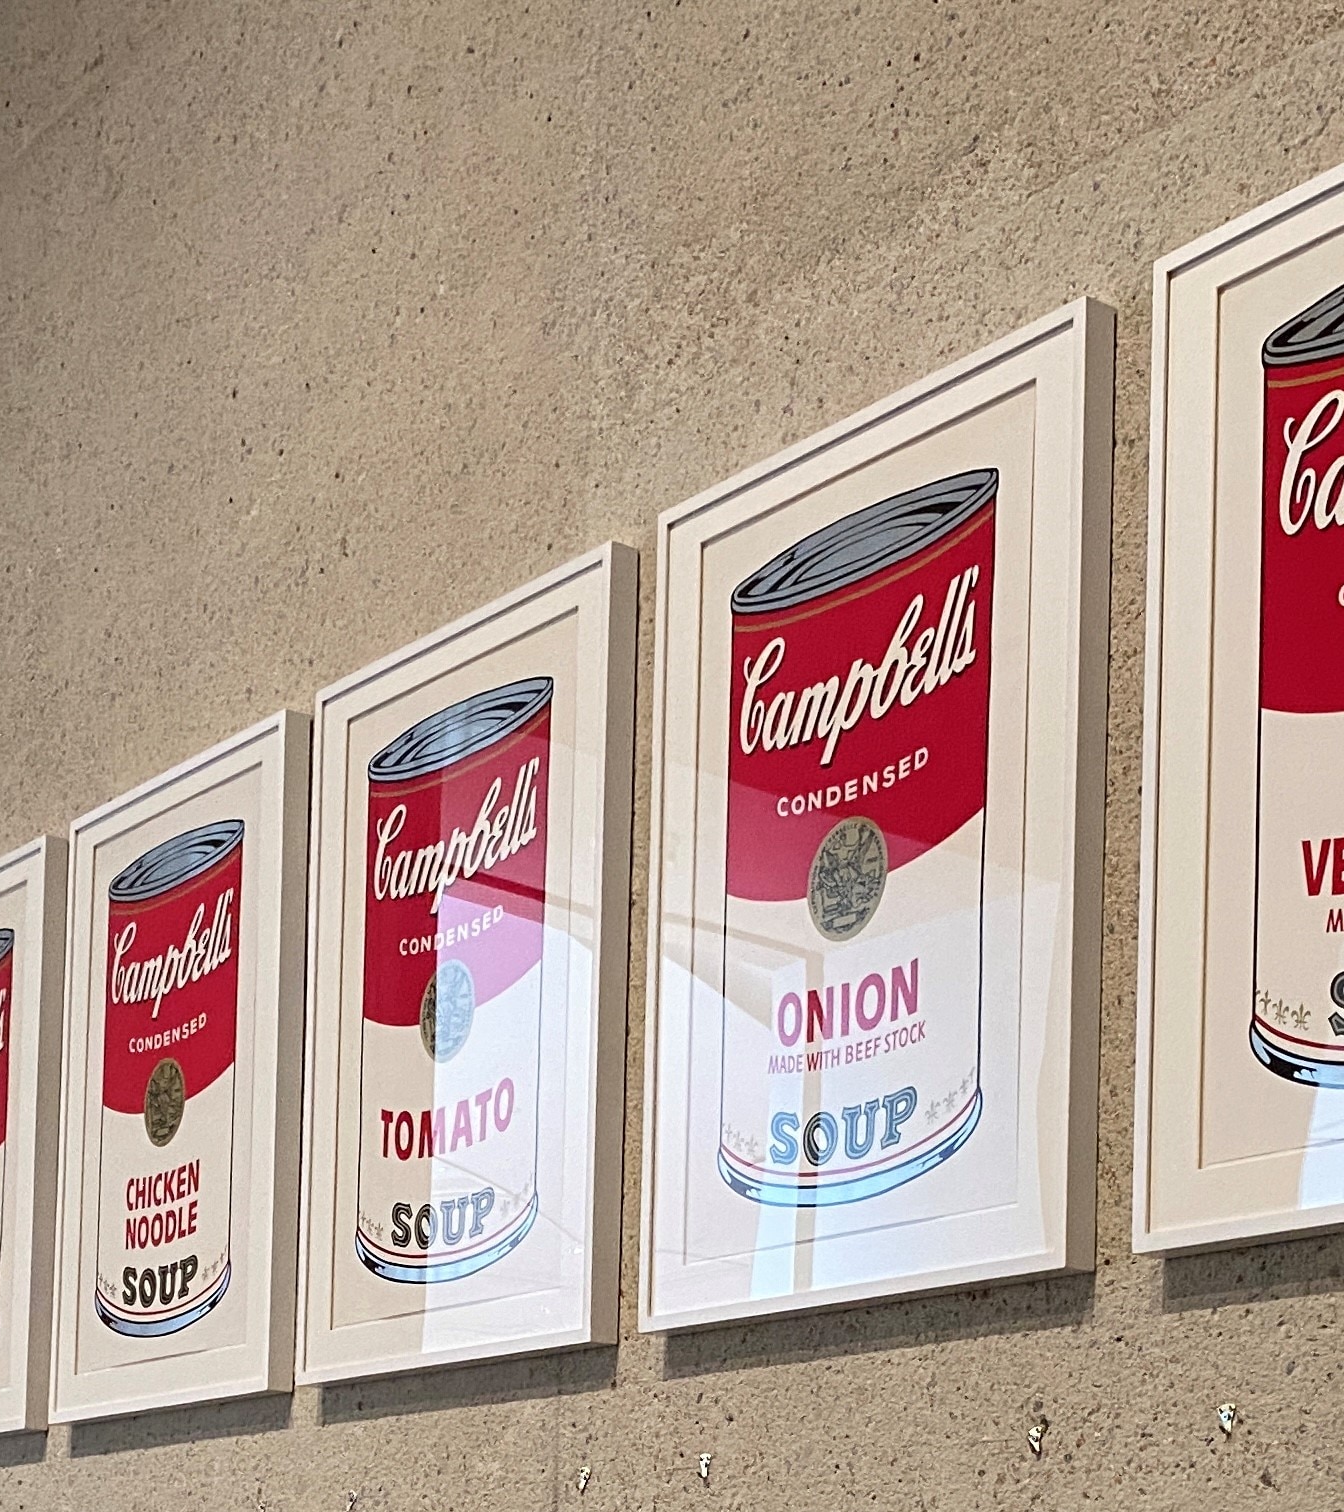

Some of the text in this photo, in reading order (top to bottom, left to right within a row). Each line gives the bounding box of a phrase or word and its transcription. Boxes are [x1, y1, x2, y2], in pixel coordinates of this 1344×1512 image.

[739, 564, 980, 766] Campbell's
[776, 746, 929, 817] CONDENSED
[374, 756, 540, 915] Campbell's
[111, 887, 234, 1019] Campbell's
[399, 905, 504, 956] CONDENSED
[128, 1012, 207, 1053] CONDENSED
[777, 957, 919, 1048] ONION
[767, 1020, 926, 1075] MADE WITH BEEF STOCK
[380, 1077, 515, 1161] TOMATO
[769, 1085, 918, 1167] SOUP
[126, 1158, 200, 1212] CHICKEN
[390, 1186, 496, 1250] SOUP
[125, 1199, 198, 1250] NOODLE
[121, 1254, 199, 1308] SOUP
